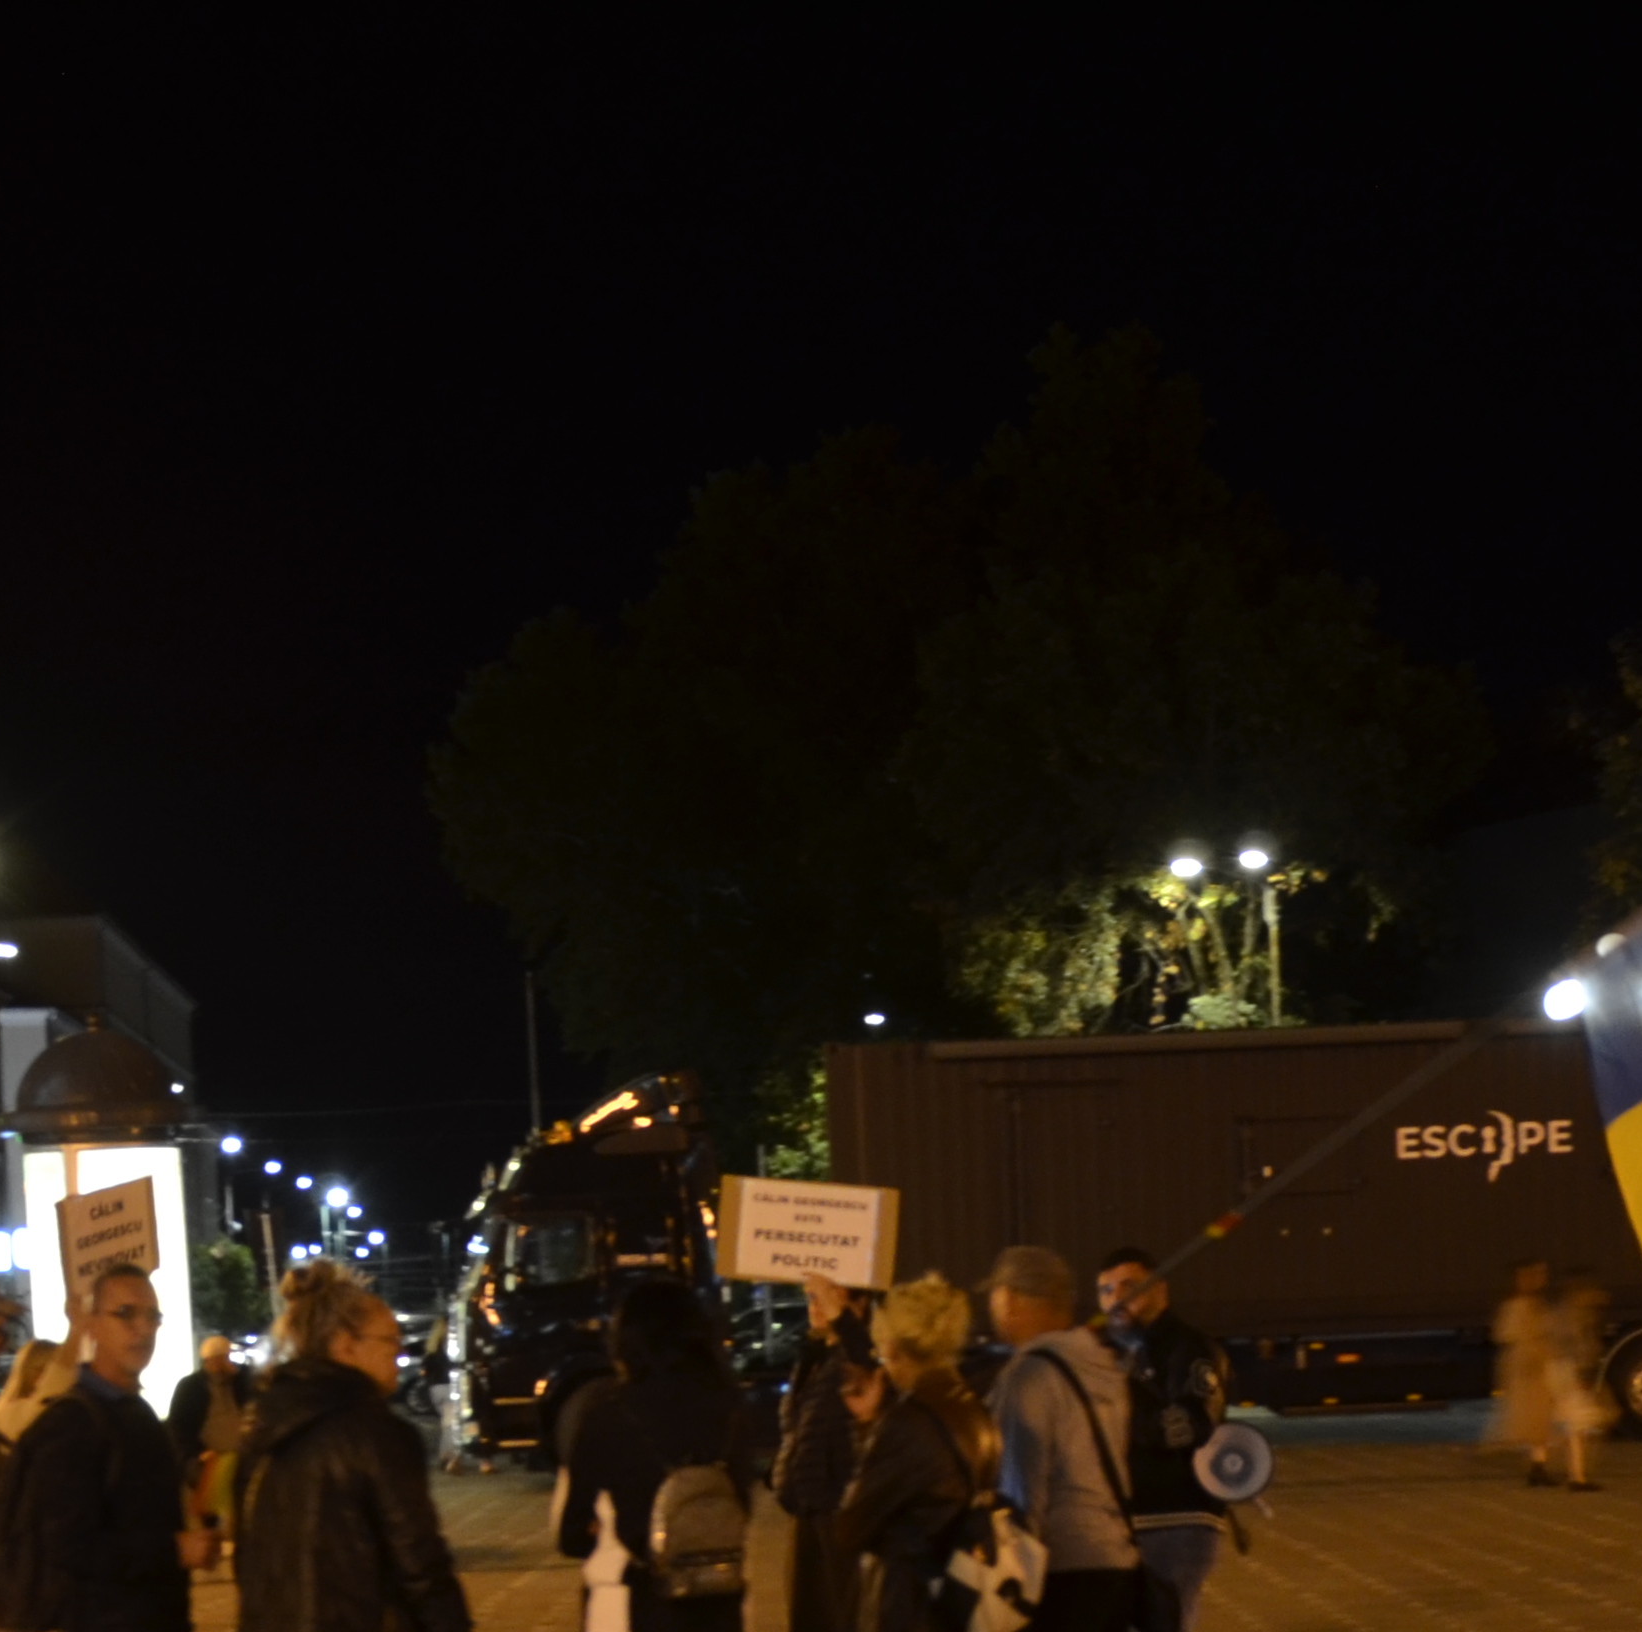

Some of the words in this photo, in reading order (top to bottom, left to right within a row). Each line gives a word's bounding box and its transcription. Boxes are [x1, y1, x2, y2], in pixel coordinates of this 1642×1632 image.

[77, 1221, 142, 1250] GEORGESCU
[755, 1229, 859, 1247] PERSECUTAT
[771, 1254, 838, 1270] POLITIC
